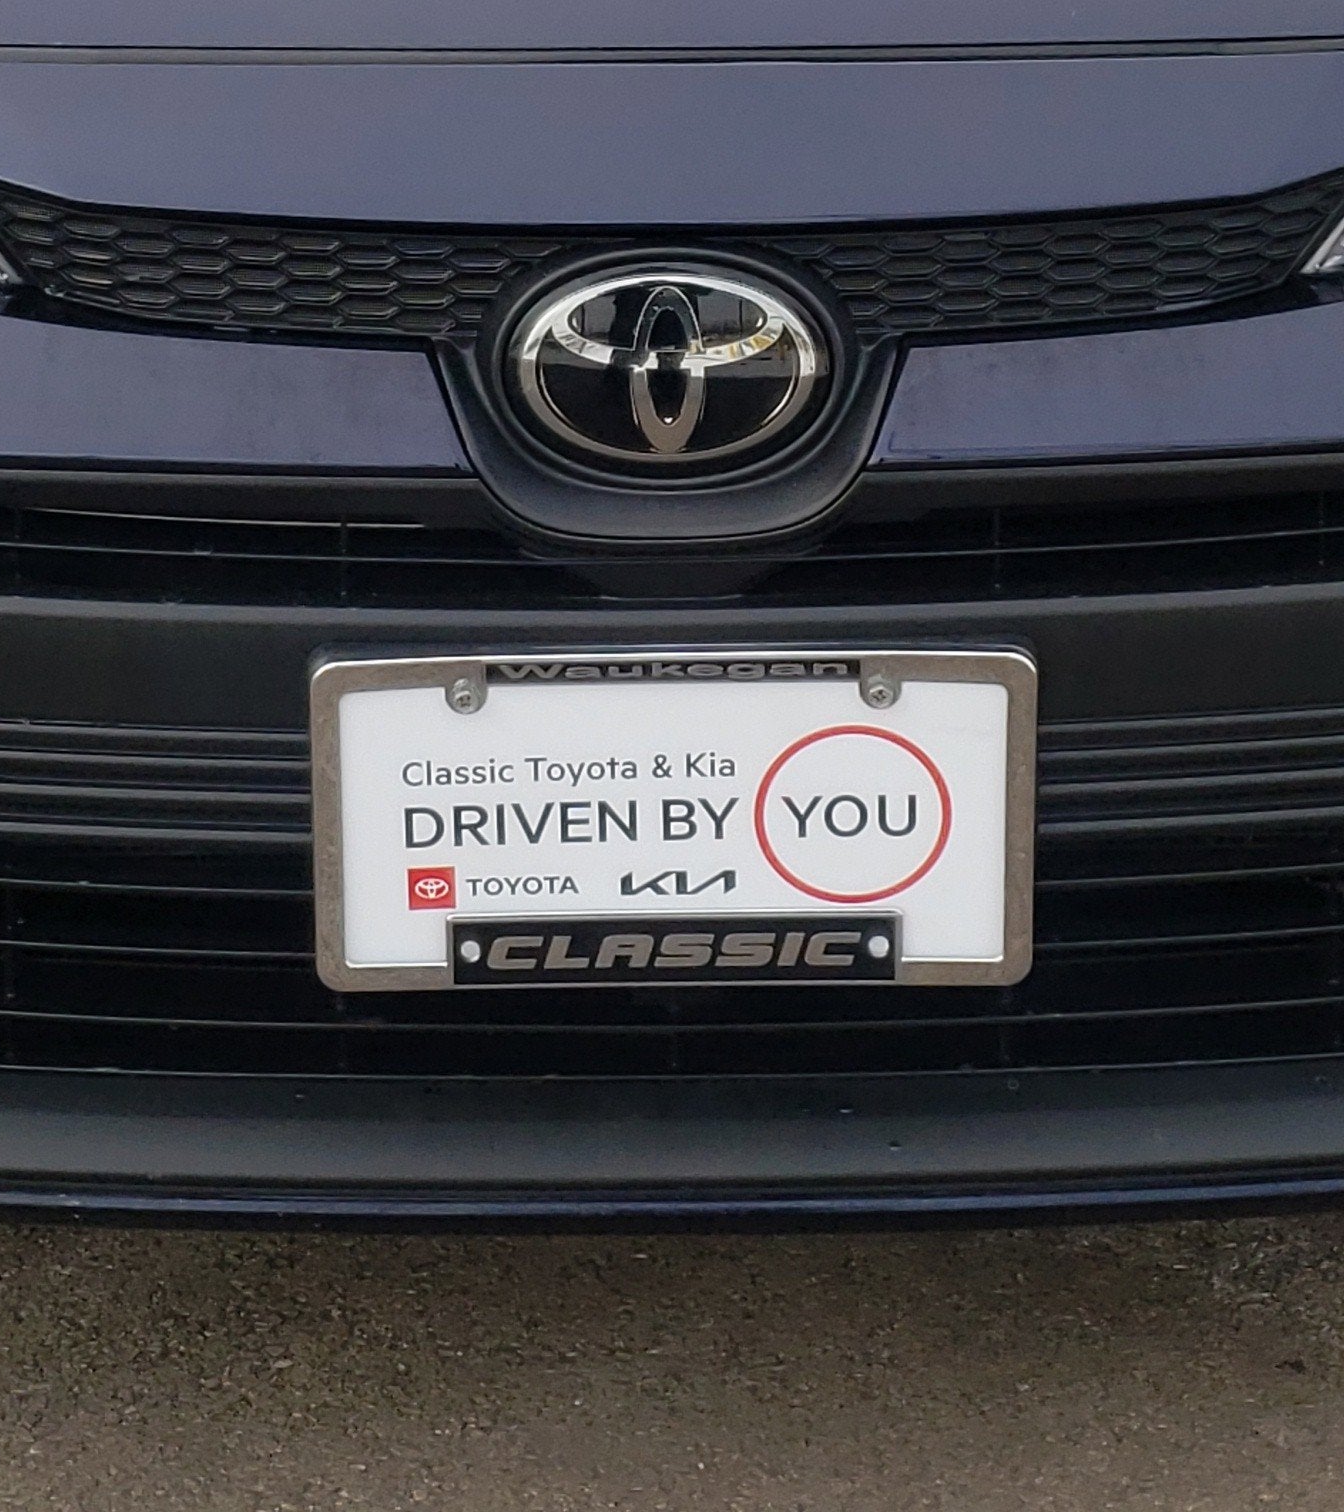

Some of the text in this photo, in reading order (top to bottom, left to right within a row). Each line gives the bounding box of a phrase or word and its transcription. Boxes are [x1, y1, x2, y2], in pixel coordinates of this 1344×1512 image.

[498, 660, 849, 680] Waukegan
[402, 752, 736, 787] Classic Toyota & Kia
[404, 794, 919, 849] DRIVEN BY YOU
[466, 876, 579, 897] TOYOTA
[486, 931, 863, 970] CLASSIC
